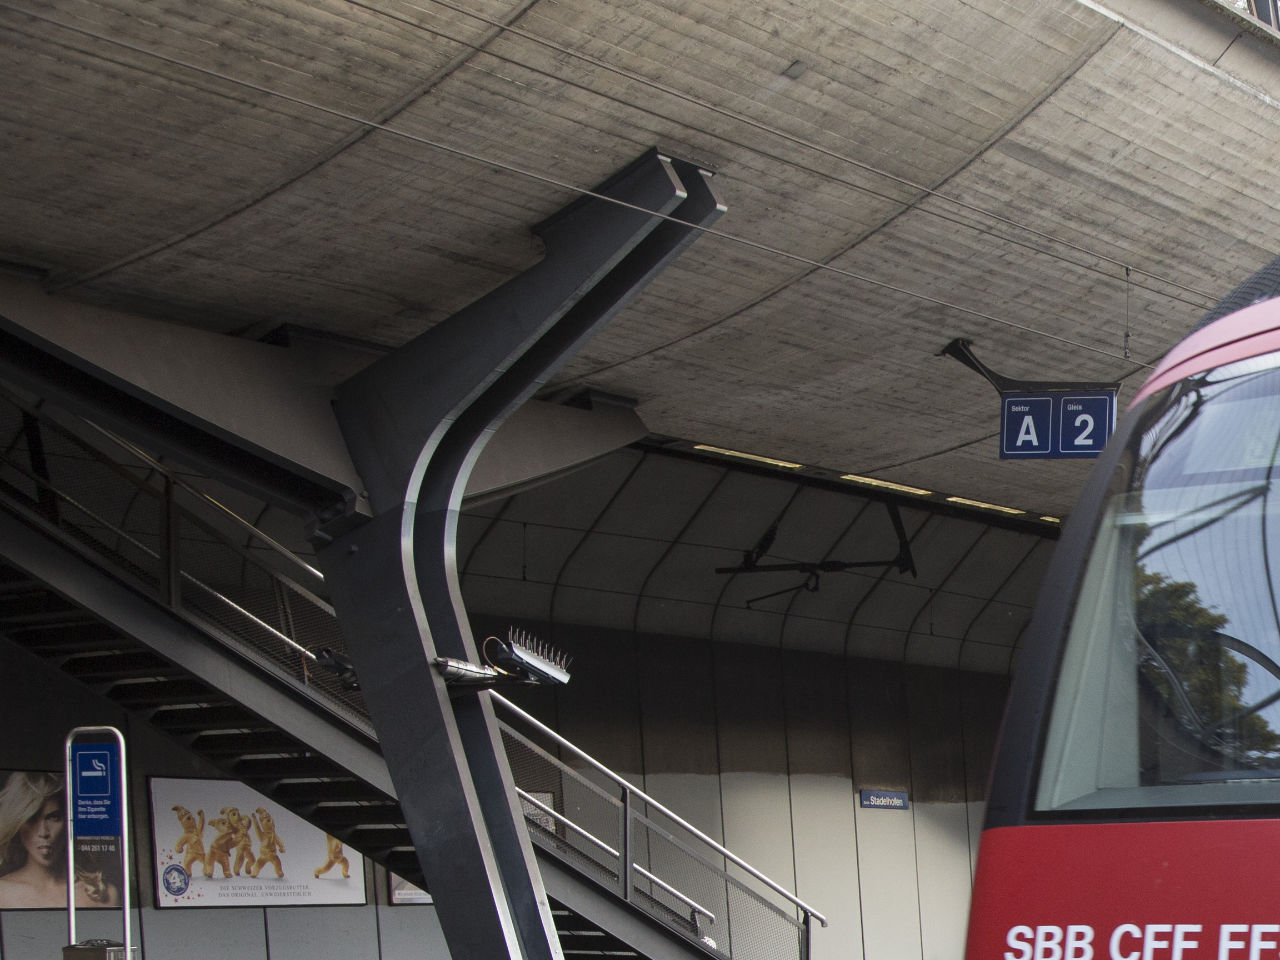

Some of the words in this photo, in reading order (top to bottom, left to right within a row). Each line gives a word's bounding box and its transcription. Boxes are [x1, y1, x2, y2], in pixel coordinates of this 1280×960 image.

[1067, 403, 1083, 411] Gleis
[1016, 415, 1039, 446] A
[1073, 413, 1095, 445] 2
[870, 796, 903, 806] Stadelhofen
